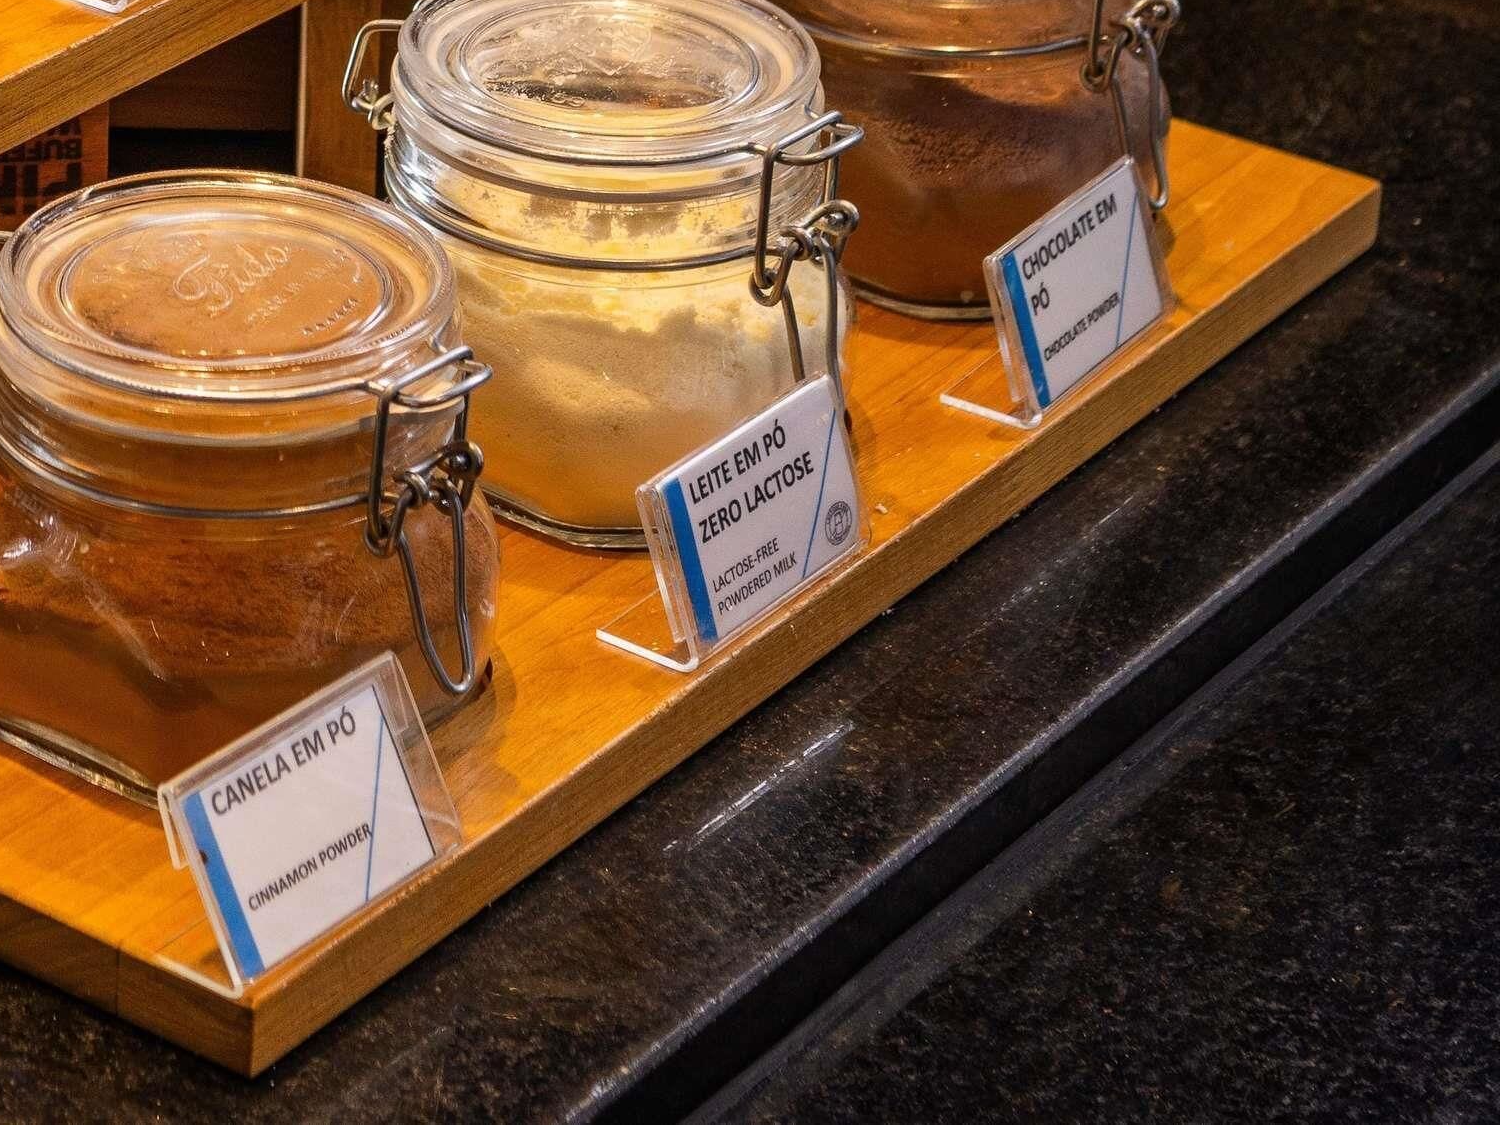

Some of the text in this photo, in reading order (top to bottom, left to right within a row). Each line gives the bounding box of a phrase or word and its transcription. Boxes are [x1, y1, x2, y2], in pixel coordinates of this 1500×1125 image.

[1021, 193, 1118, 280] CHOCOLATE EM
[1031, 282, 1050, 316] PÓ
[1044, 291, 1121, 361] CHOCOLATE POWDER
[689, 419, 787, 505] LEITE EM PÓ
[699, 451, 815, 544] ZERO LACTOSE
[713, 538, 780, 593] LACTOSE-FREE
[718, 551, 798, 615] POWDERED MILK
[211, 706, 356, 815] CANELA EM PÓ
[248, 823, 374, 911] CINNAMON POWDER
